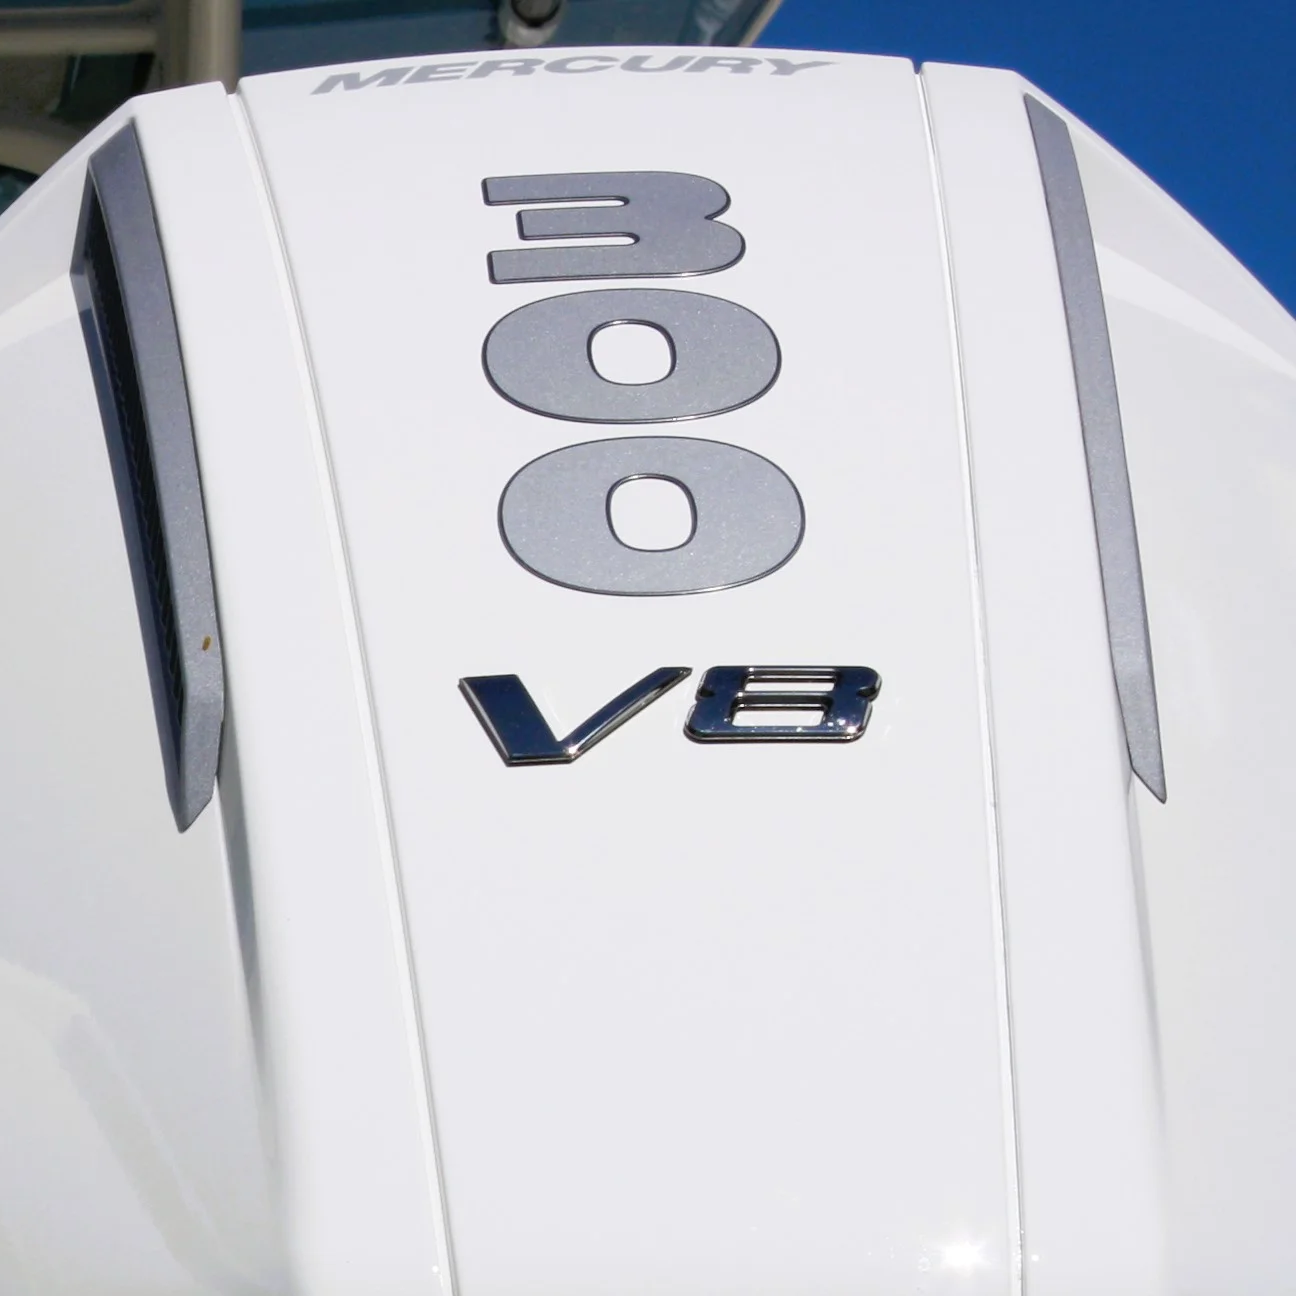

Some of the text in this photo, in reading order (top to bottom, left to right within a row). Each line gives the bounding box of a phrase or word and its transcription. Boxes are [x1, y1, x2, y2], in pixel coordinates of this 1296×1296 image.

[310, 55, 836, 95] MERCURY
[481, 170, 805, 596] 300
[457, 665, 883, 767] V8
